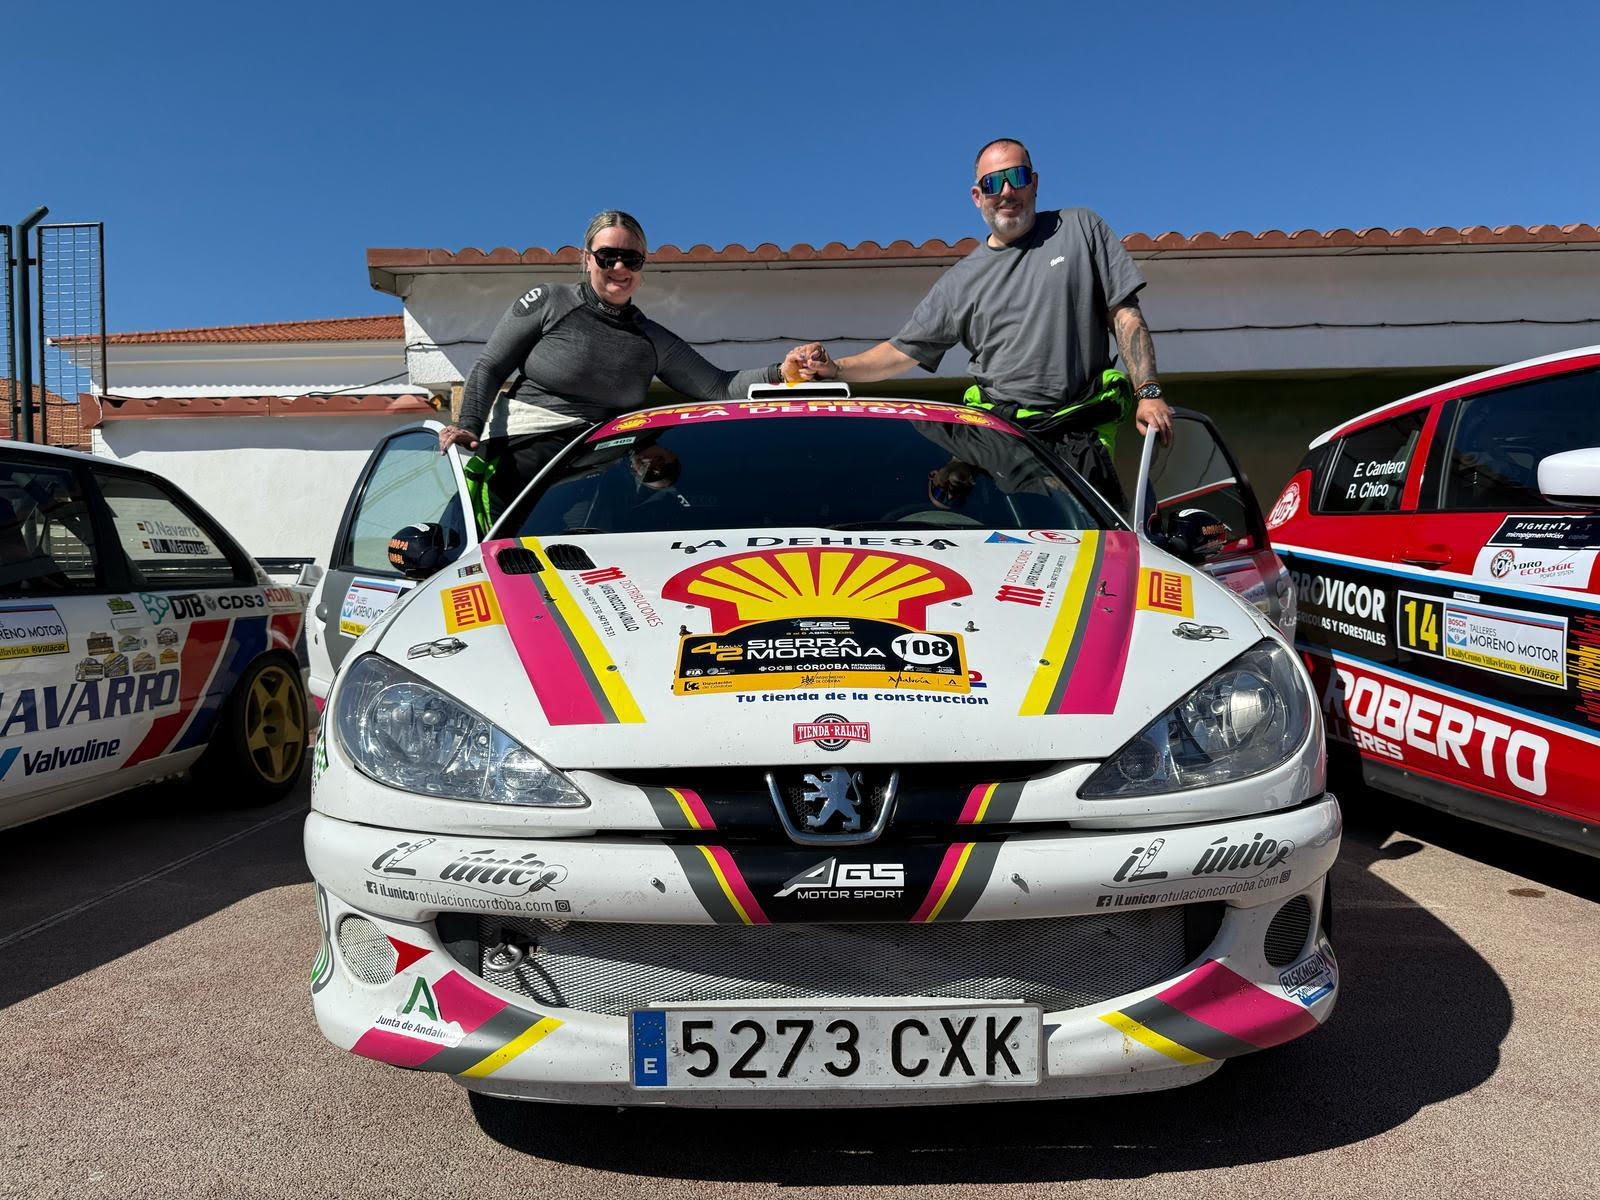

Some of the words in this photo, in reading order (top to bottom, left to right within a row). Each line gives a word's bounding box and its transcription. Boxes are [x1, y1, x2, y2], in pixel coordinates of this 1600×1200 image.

[680, 409, 729, 420] LA
[750, 405, 927, 417] DEHESA
[1365, 460, 1406, 477] Cantero
[1345, 483, 1357, 499] R.
[1359, 481, 1389, 499] Chico
[1515, 522, 1572, 531] PIGMENTA
[670, 539, 727, 550] LA
[747, 536, 960, 548] DEHESA
[1520, 562, 1575, 576] ECOLOGIC
[1148, 571, 1182, 612] PIRELLI
[167, 594, 206, 620] DIB
[218, 595, 265, 609] CDS3
[451, 584, 491, 627] PIRELLI
[1404, 600, 1439, 652] 14
[1448, 617, 1467, 628] BOSCH
[1470, 623, 1497, 637] TALLERES
[27, 625, 64, 638] MOTOR
[1339, 622, 1387, 647] FORESTALES
[747, 637, 860, 649] SIERRA
[895, 639, 949, 657] 108
[1470, 633, 1515, 654] MORENO
[1518, 646, 1559, 664] MOTOR
[747, 647, 887, 660] MORENA
[796, 663, 850, 671] CÓRDOBA
[735, 694, 755, 703] Tu
[762, 692, 819, 702] tienda
[825, 692, 847, 701] de
[852, 692, 868, 701] la
[874, 693, 989, 705] construcción
[798, 726, 830, 740] TIENDA
[834, 725, 867, 739] RALLYE
[23, 737, 120, 776] Valvoline
[797, 890, 851, 898] MOTOR
[853, 889, 905, 898] SPORT
[375, 1014, 401, 1028] Junta
[401, 1020, 412, 1031] de
[682, 1018, 862, 1078] 5273
[890, 1014, 1022, 1077] CXK
[643, 1057, 658, 1074] E
